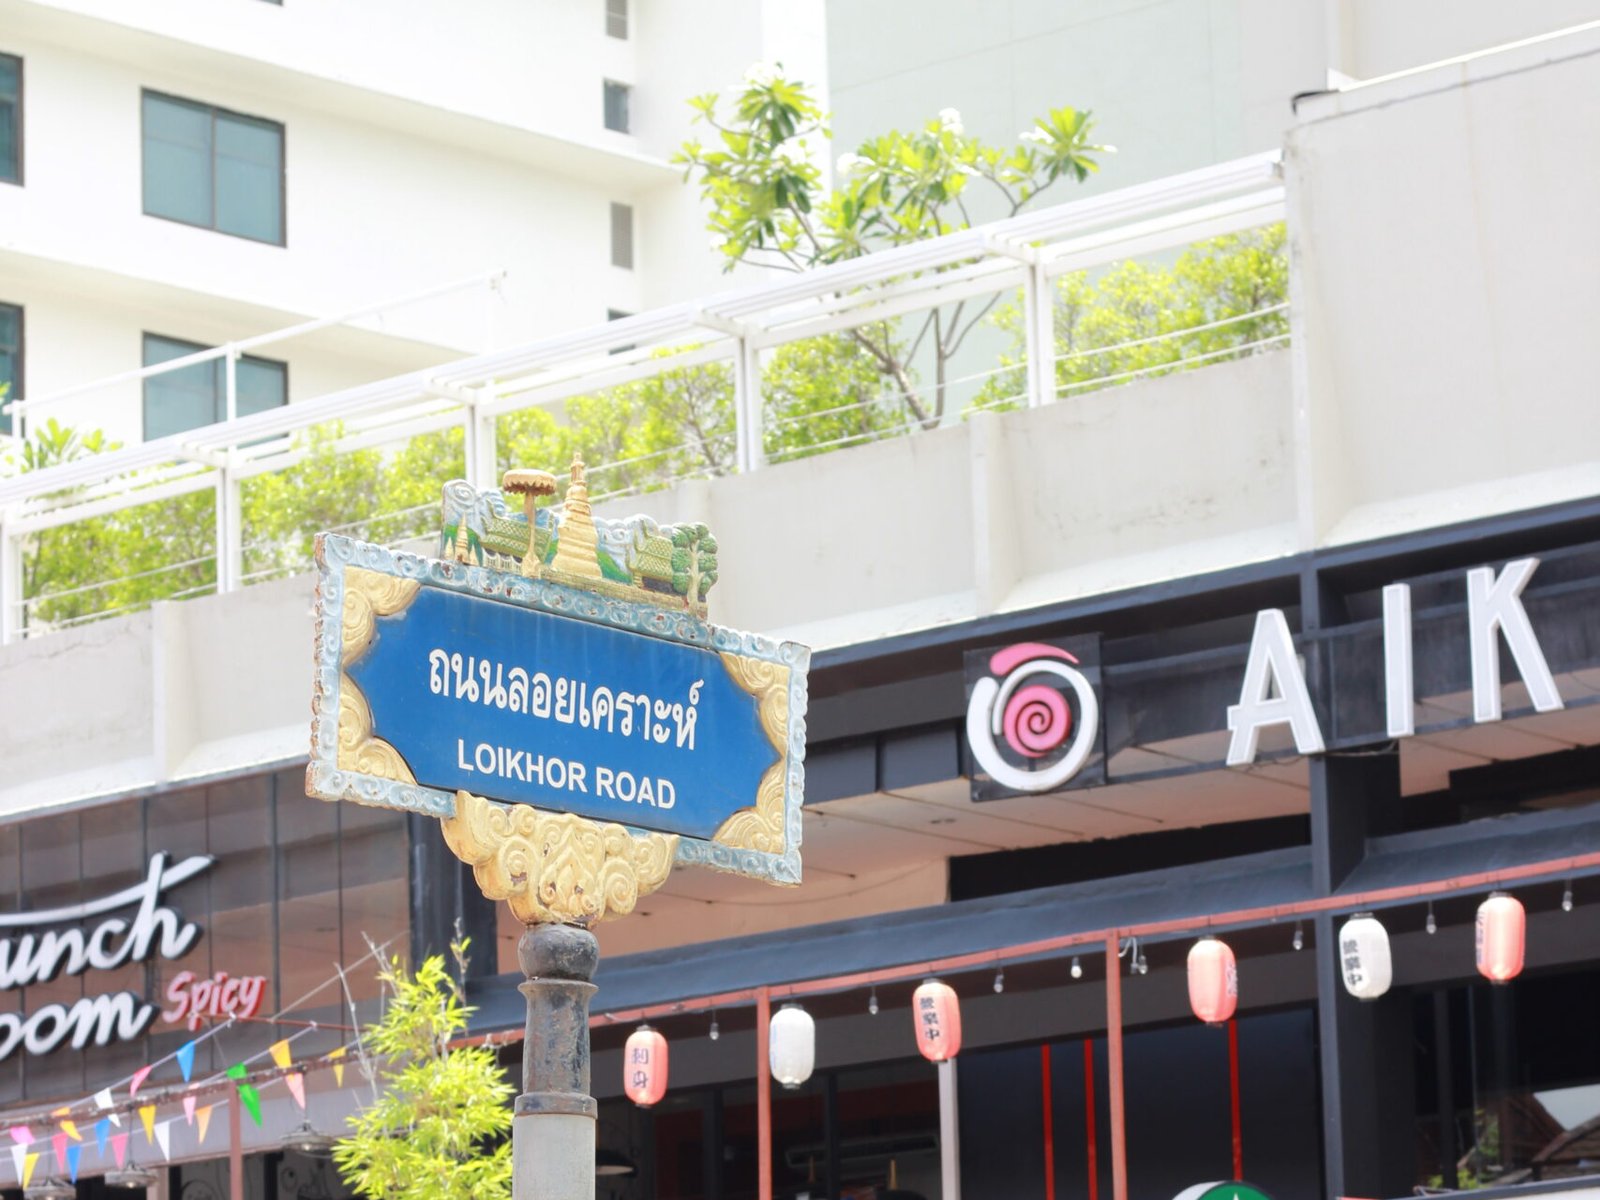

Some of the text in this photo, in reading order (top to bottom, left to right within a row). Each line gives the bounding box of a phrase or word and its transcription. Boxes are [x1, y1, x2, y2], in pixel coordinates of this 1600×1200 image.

[429, 648, 705, 751] ถนนลอยเคราะห์
[1226, 557, 1565, 766] AIK
[457, 738, 676, 810] LOIKHOR ROAD
[163, 971, 265, 1031] Spicy
